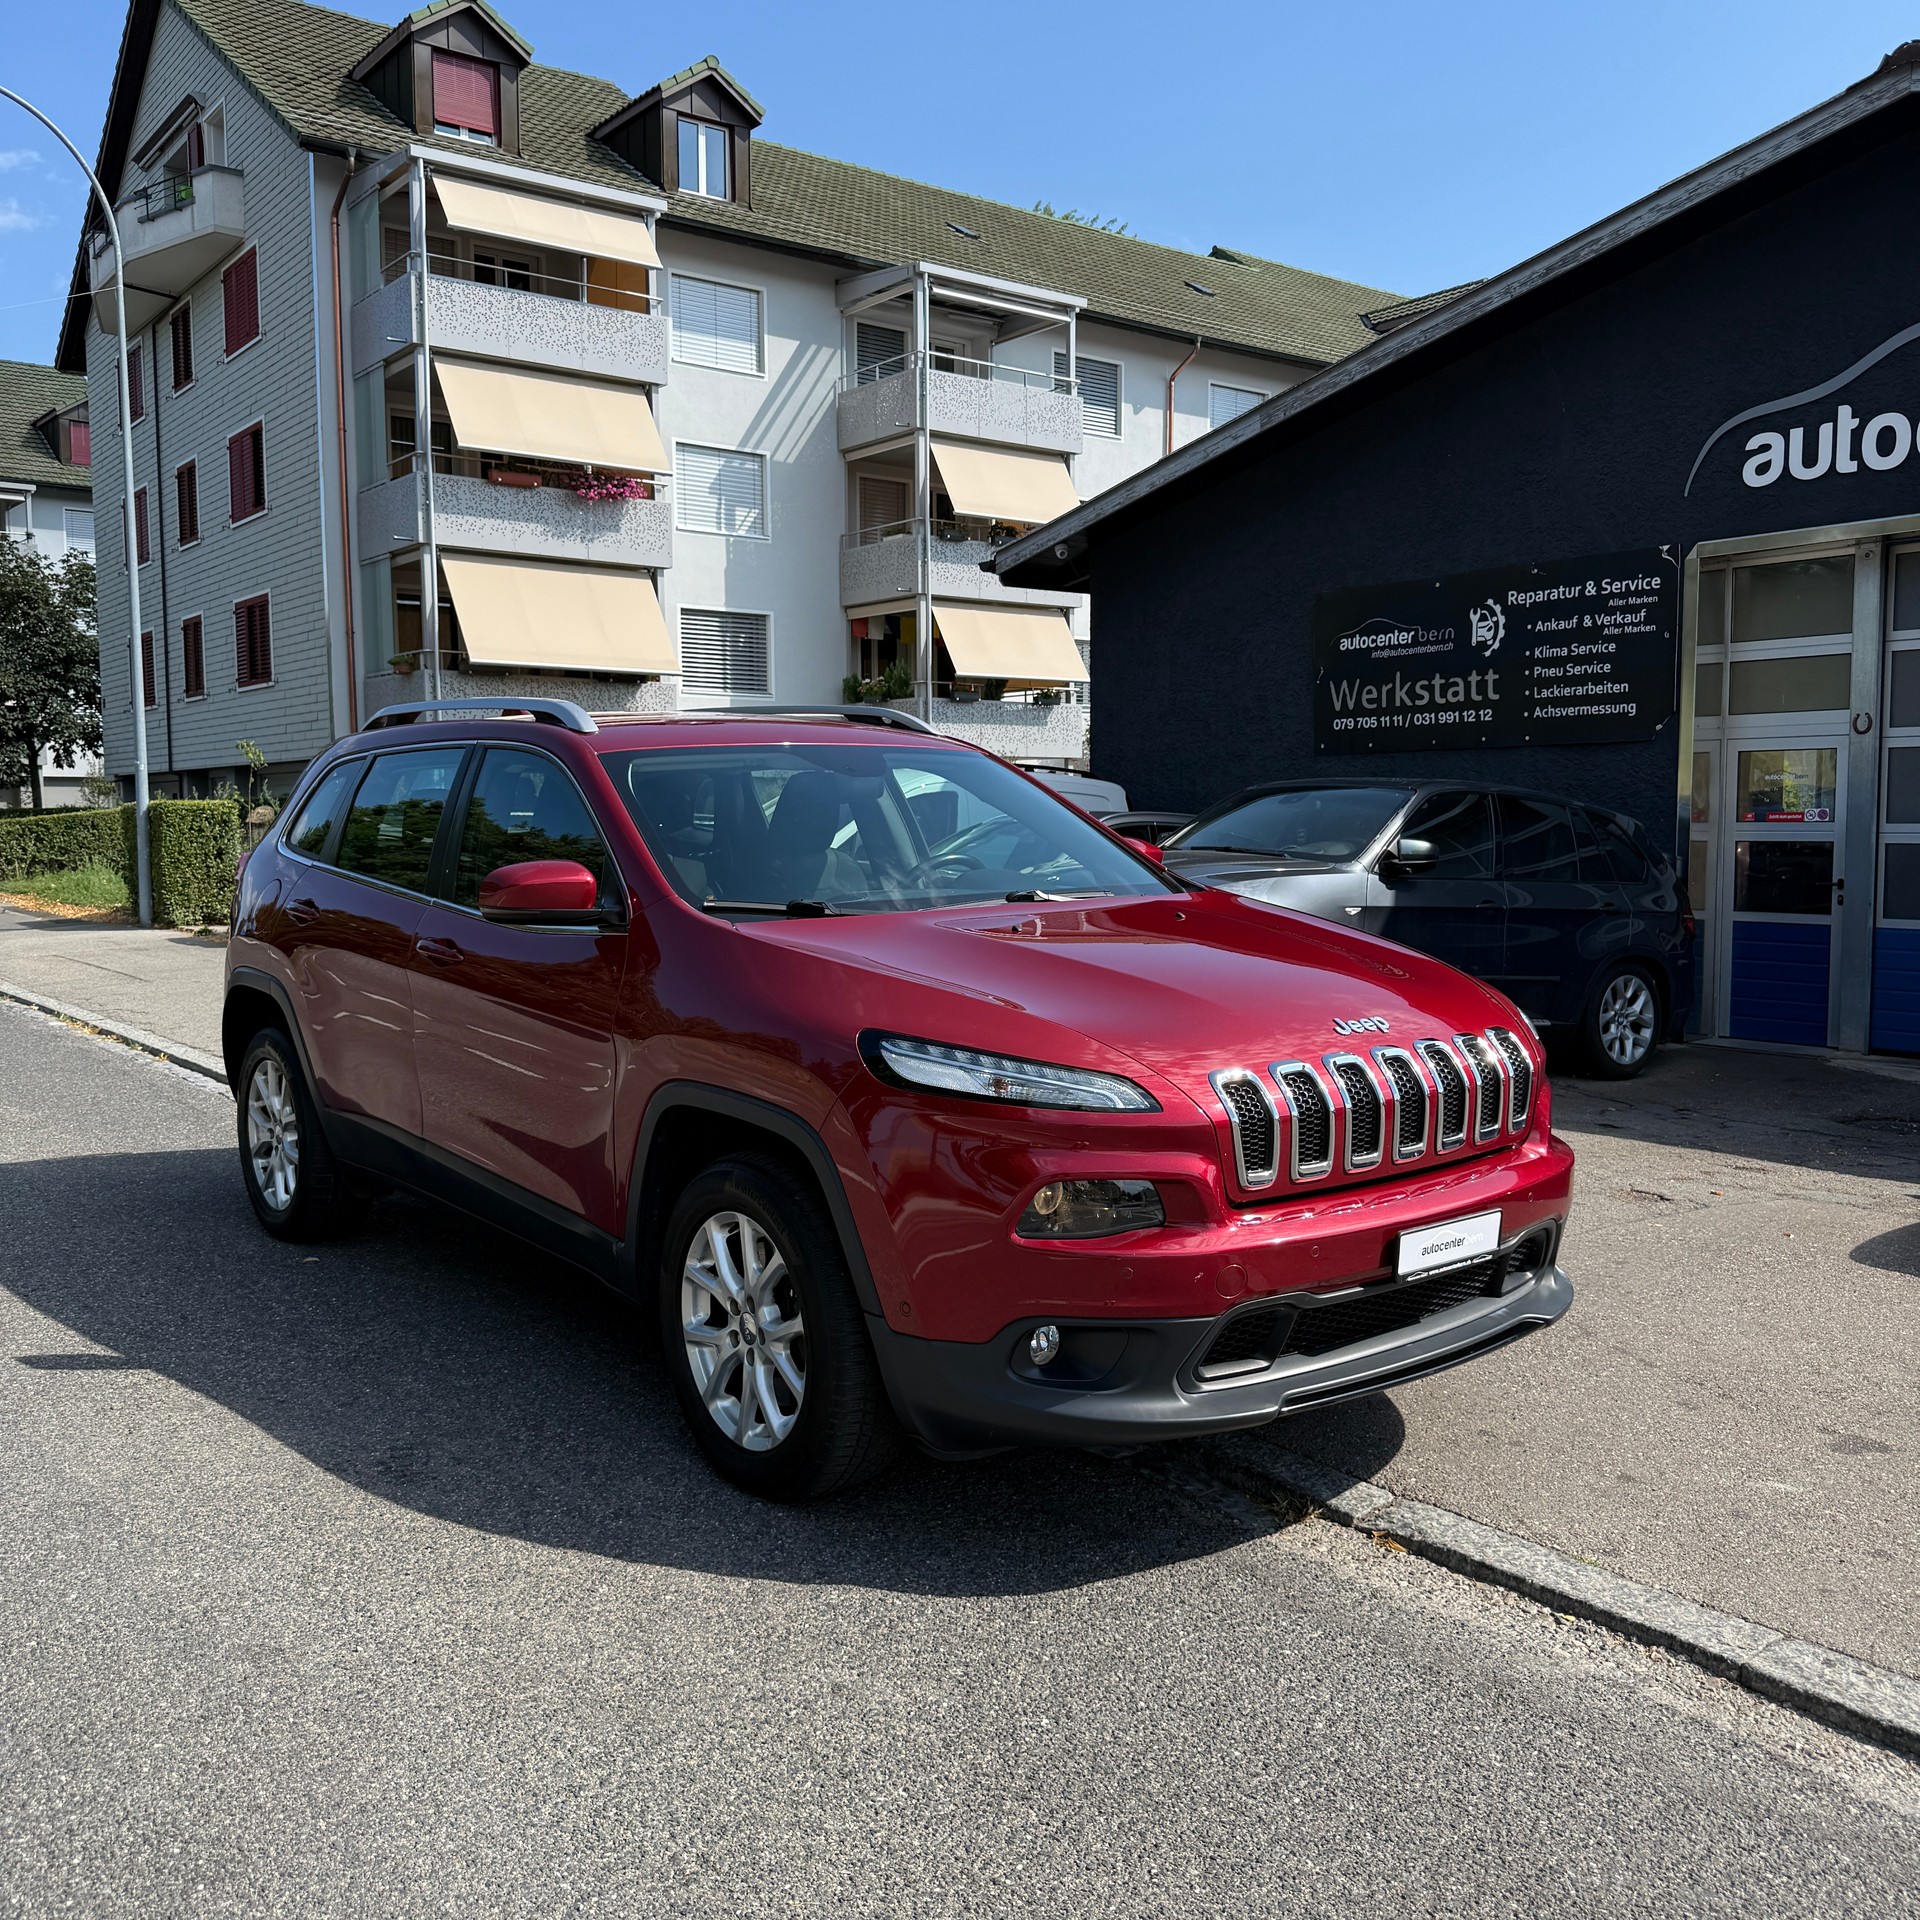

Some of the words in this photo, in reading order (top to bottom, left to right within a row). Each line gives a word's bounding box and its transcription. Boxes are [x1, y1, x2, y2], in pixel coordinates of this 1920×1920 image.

[1742, 404, 1920, 488] auto
[1507, 585, 1582, 608] Reparatur
[1584, 580, 1597, 596] &
[1600, 573, 1661, 594] Service
[1608, 598, 1626, 607] Aller
[1628, 595, 1658, 606] Marken
[1534, 615, 1579, 632] Ankauf
[1582, 614, 1593, 628] &
[1595, 608, 1647, 626] Verkauf
[1603, 626, 1622, 636] Aller
[1624, 623, 1656, 634] Marken
[1339, 629, 1415, 651] autocenter
[1371, 641, 1454, 659] info@autocenterbern.ch
[1534, 645, 1568, 659] Klima
[1570, 640, 1616, 656] Service
[1534, 666, 1563, 678] Pneu
[1565, 660, 1611, 676] Service
[1329, 667, 1500, 712] Werkstatt
[1533, 681, 1629, 699] Lackierarbeiten
[1333, 718, 1354, 731] 079
[1356, 716, 1378, 728] 705
[1405, 713, 1412, 728] /
[1414, 712, 1436, 725] 031
[1438, 711, 1459, 723] 991
[1462, 709, 1476, 722] 12
[1478, 708, 1493, 721] 12
[1533, 702, 1637, 718] Achsvermessung
[1333, 1015, 1390, 1036] Jeep
[1421, 1236, 1466, 1256] autocenter
